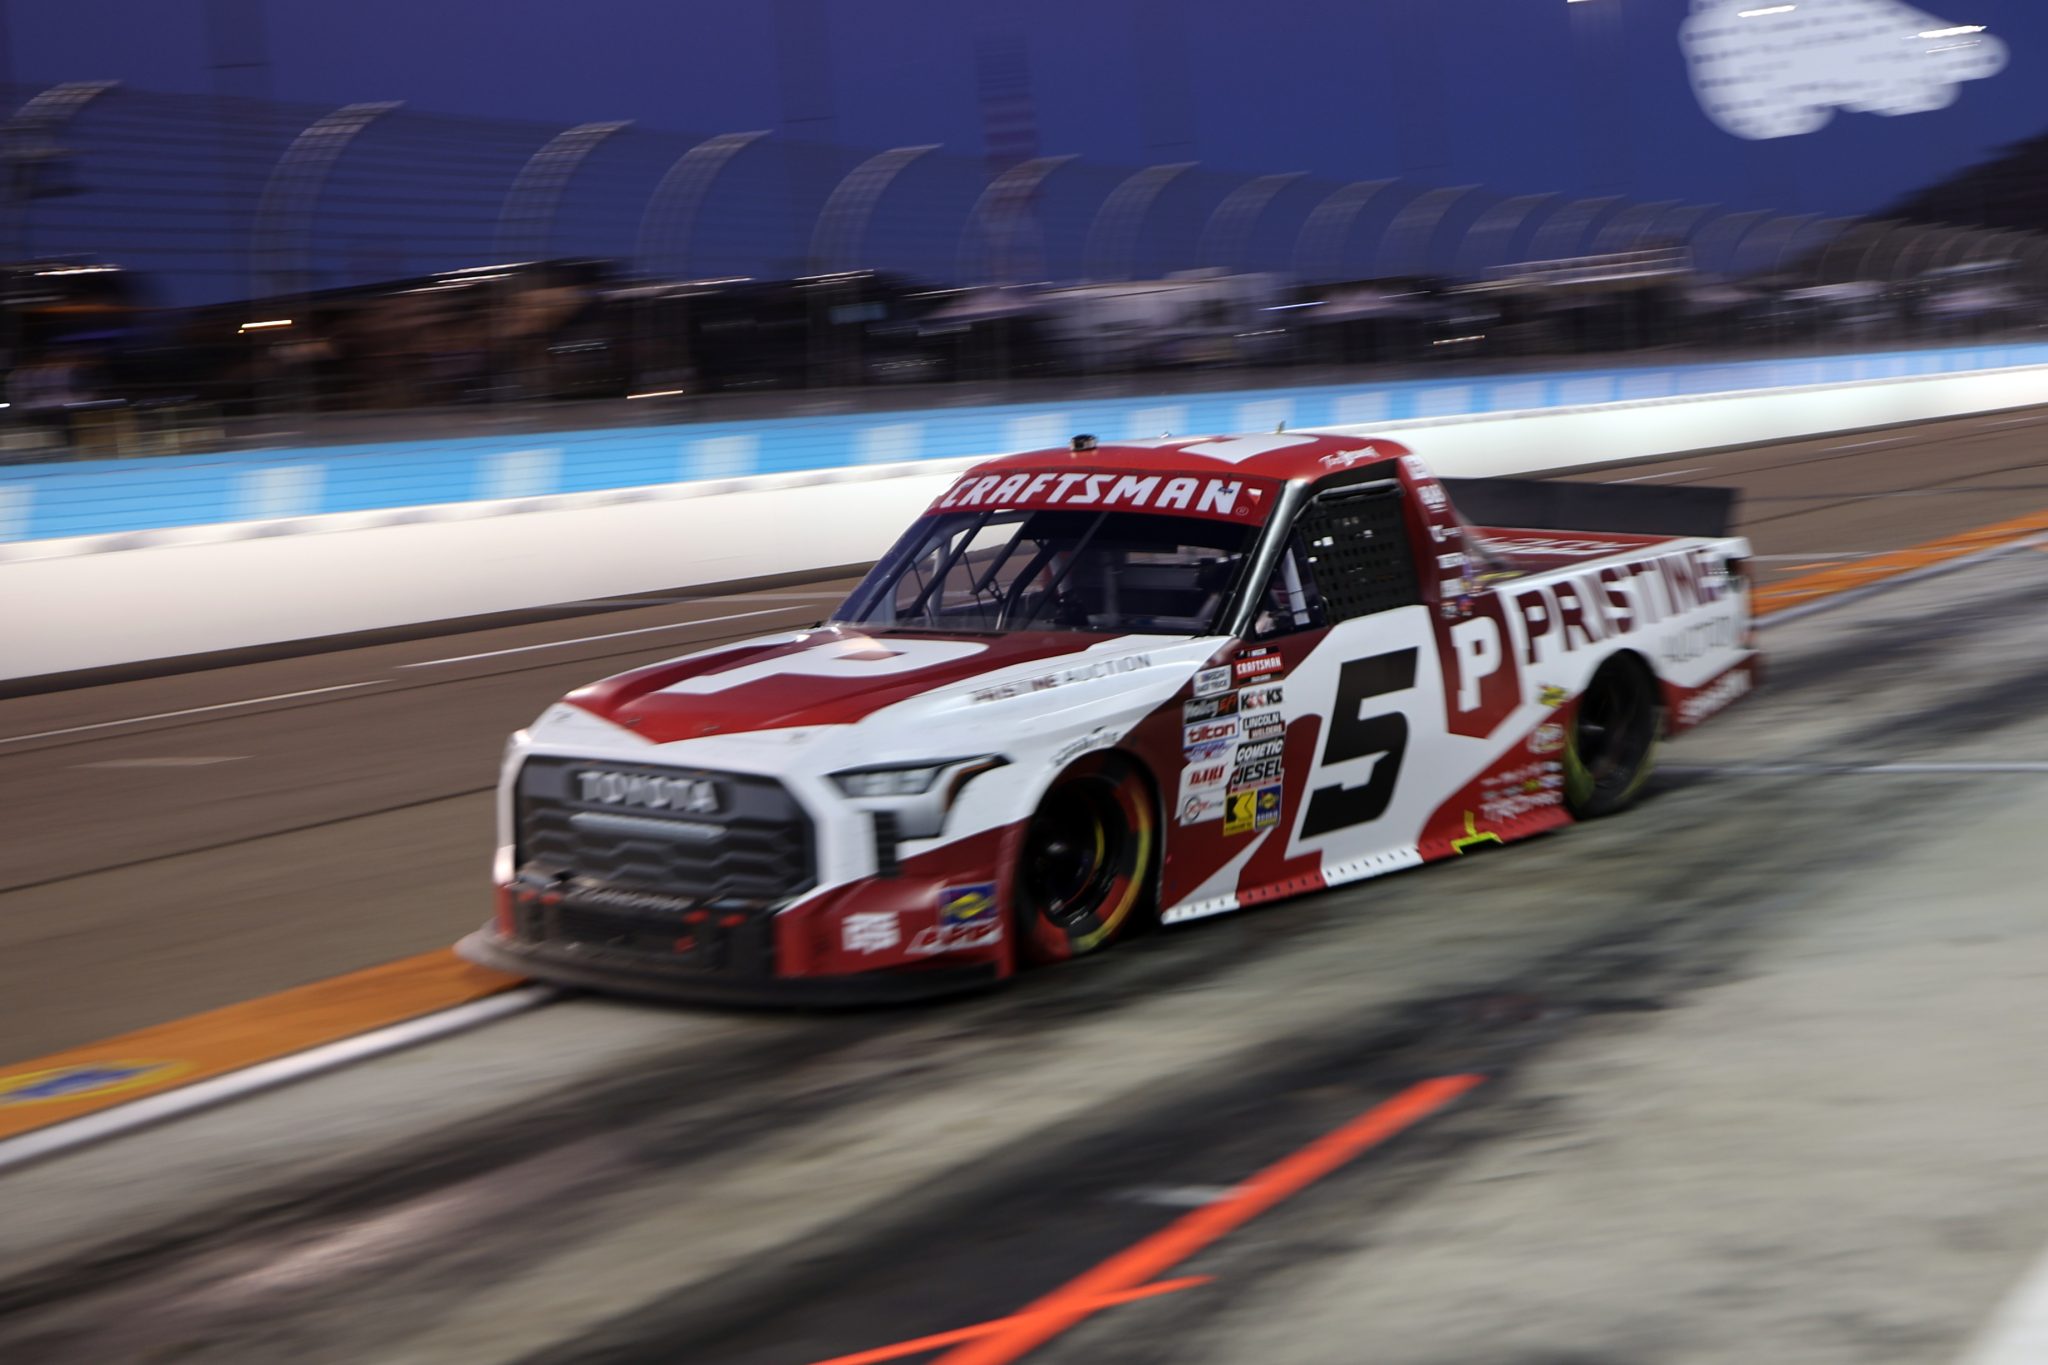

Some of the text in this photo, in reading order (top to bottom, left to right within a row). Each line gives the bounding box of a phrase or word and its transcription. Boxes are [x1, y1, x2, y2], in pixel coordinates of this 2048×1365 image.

[941, 472, 1242, 515] CRAFTSMAN
[1236, 656, 1281, 675] CRAFTSMAN
[1450, 616, 1501, 712] P
[1188, 723, 1235, 743] tilton
[1245, 712, 1279, 730] LINCOLN
[1237, 740, 1283, 762] COMETIC
[1299, 645, 1419, 841] 5
[1232, 759, 1282, 785] JESEL
[577, 771, 718, 813] TOYOTA
